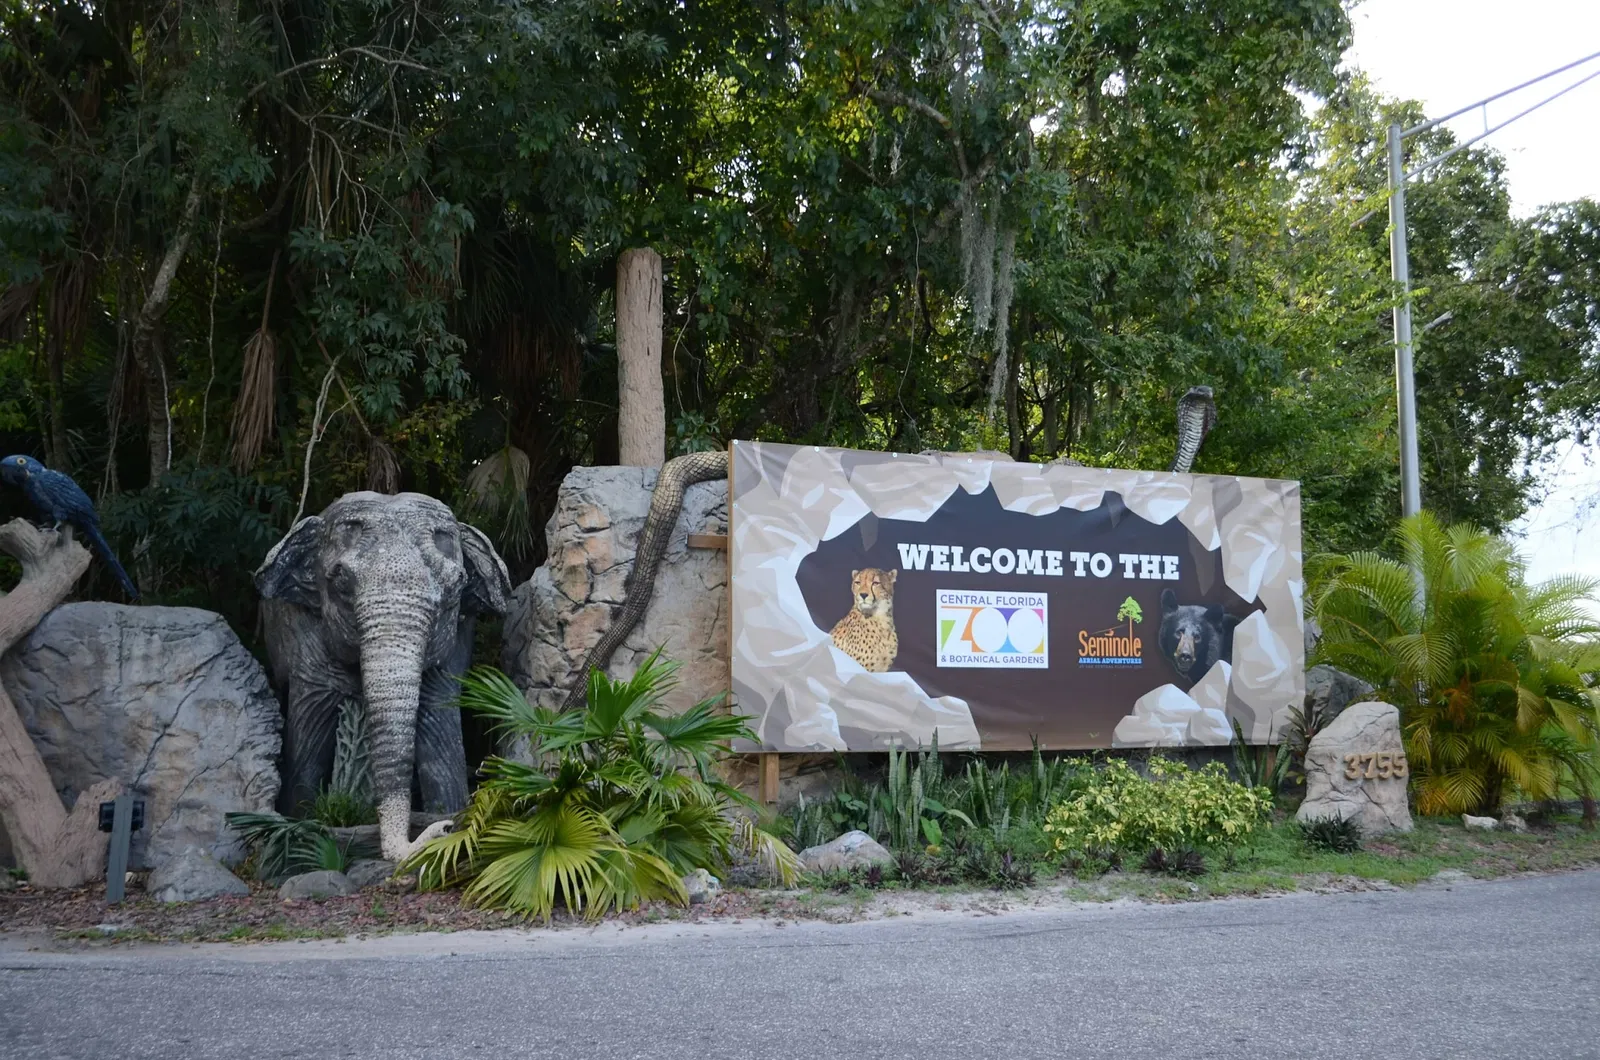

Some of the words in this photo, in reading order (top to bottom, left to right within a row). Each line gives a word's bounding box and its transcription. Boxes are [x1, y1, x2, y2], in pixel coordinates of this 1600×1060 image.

[897, 543, 1063, 576] WELCOME
[1070, 551, 1113, 578] TO
[1119, 553, 1180, 580] THE
[940, 594, 993, 605] CENTRAL
[996, 596, 1044, 606] FLORIDA
[940, 605, 1045, 654] ZOO
[1078, 630, 1142, 657] Seminole
[940, 655, 947, 663] &
[949, 655, 1001, 664] BOTANICAL
[1002, 655, 1045, 664] GARDENS
[1344, 752, 1408, 779] 3755
